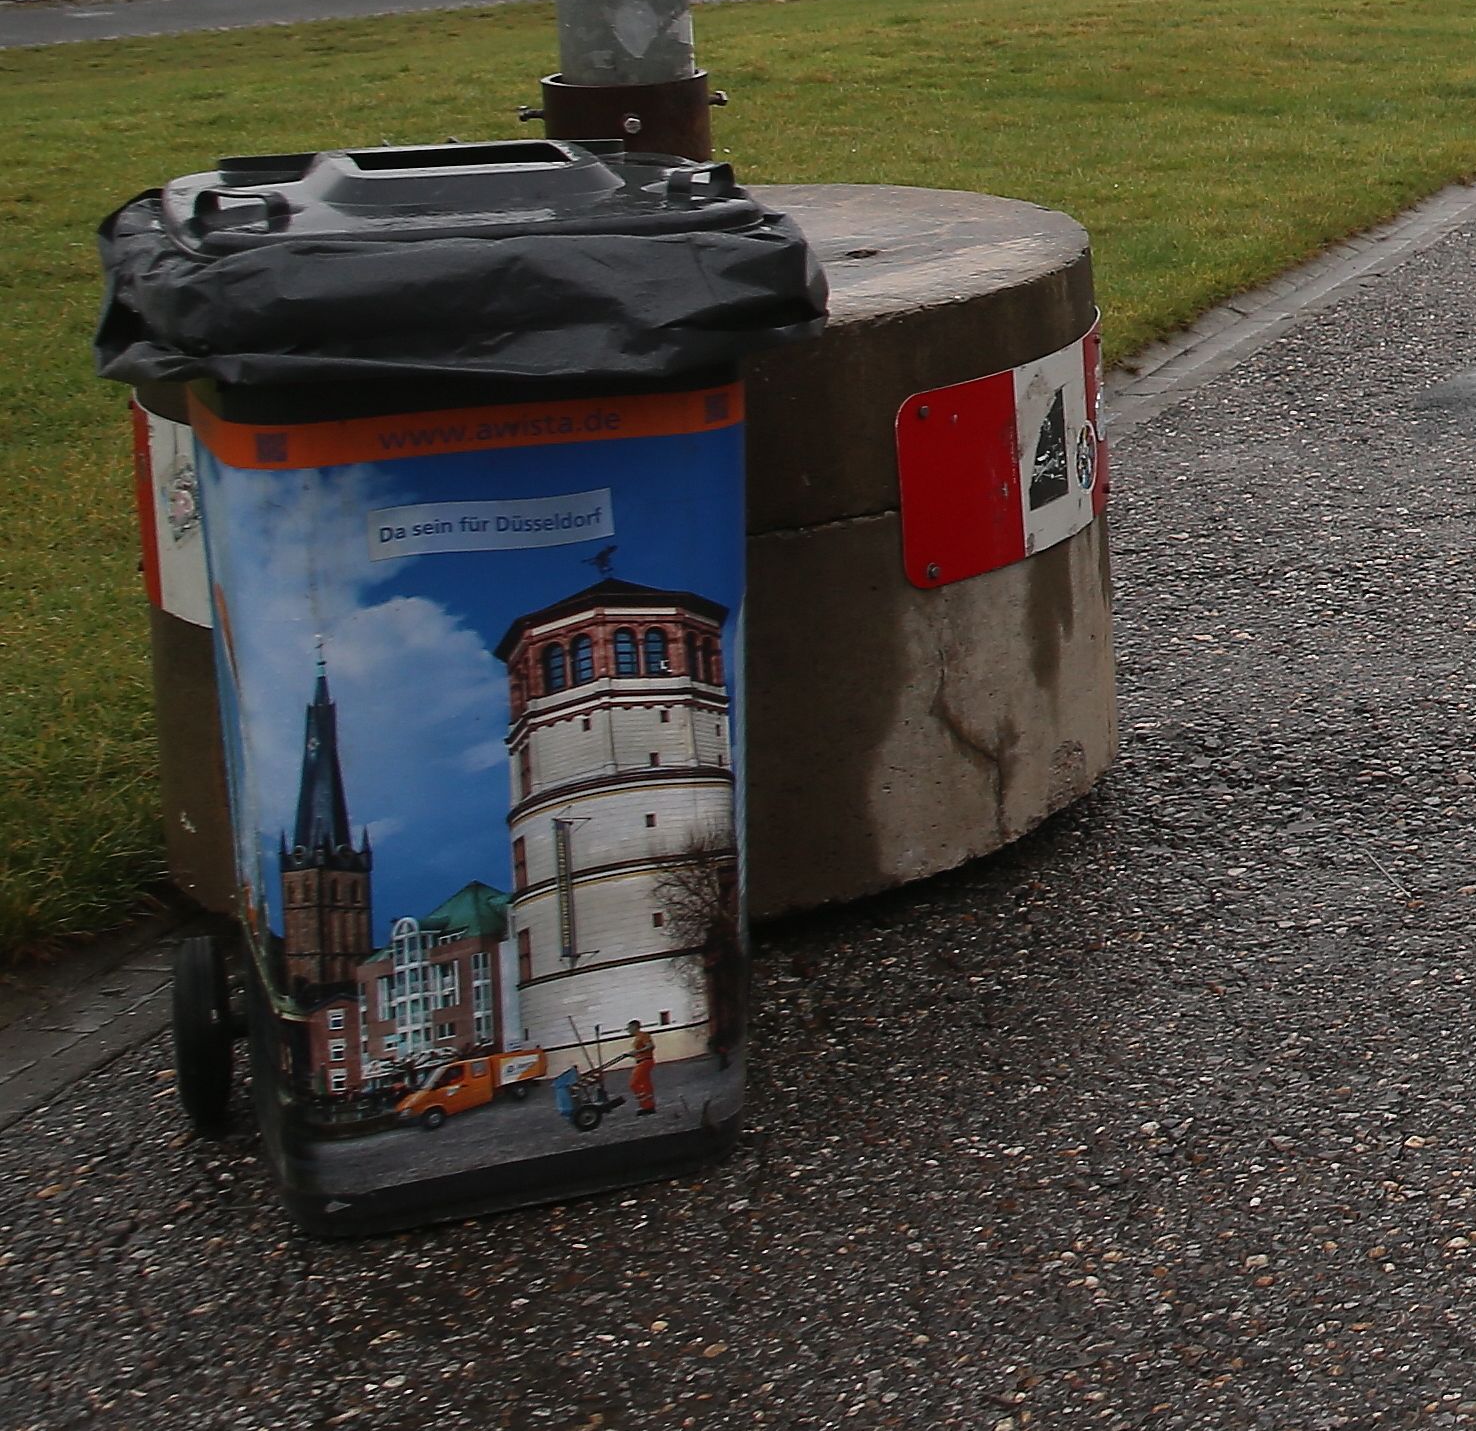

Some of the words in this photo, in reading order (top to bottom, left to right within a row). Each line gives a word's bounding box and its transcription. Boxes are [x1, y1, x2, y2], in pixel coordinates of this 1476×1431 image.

[378, 408, 622, 450] www.awista.de
[379, 525, 407, 544] Da
[412, 518, 453, 537] sein
[460, 515, 489, 533] für
[496, 507, 603, 534] Düsseldorf
